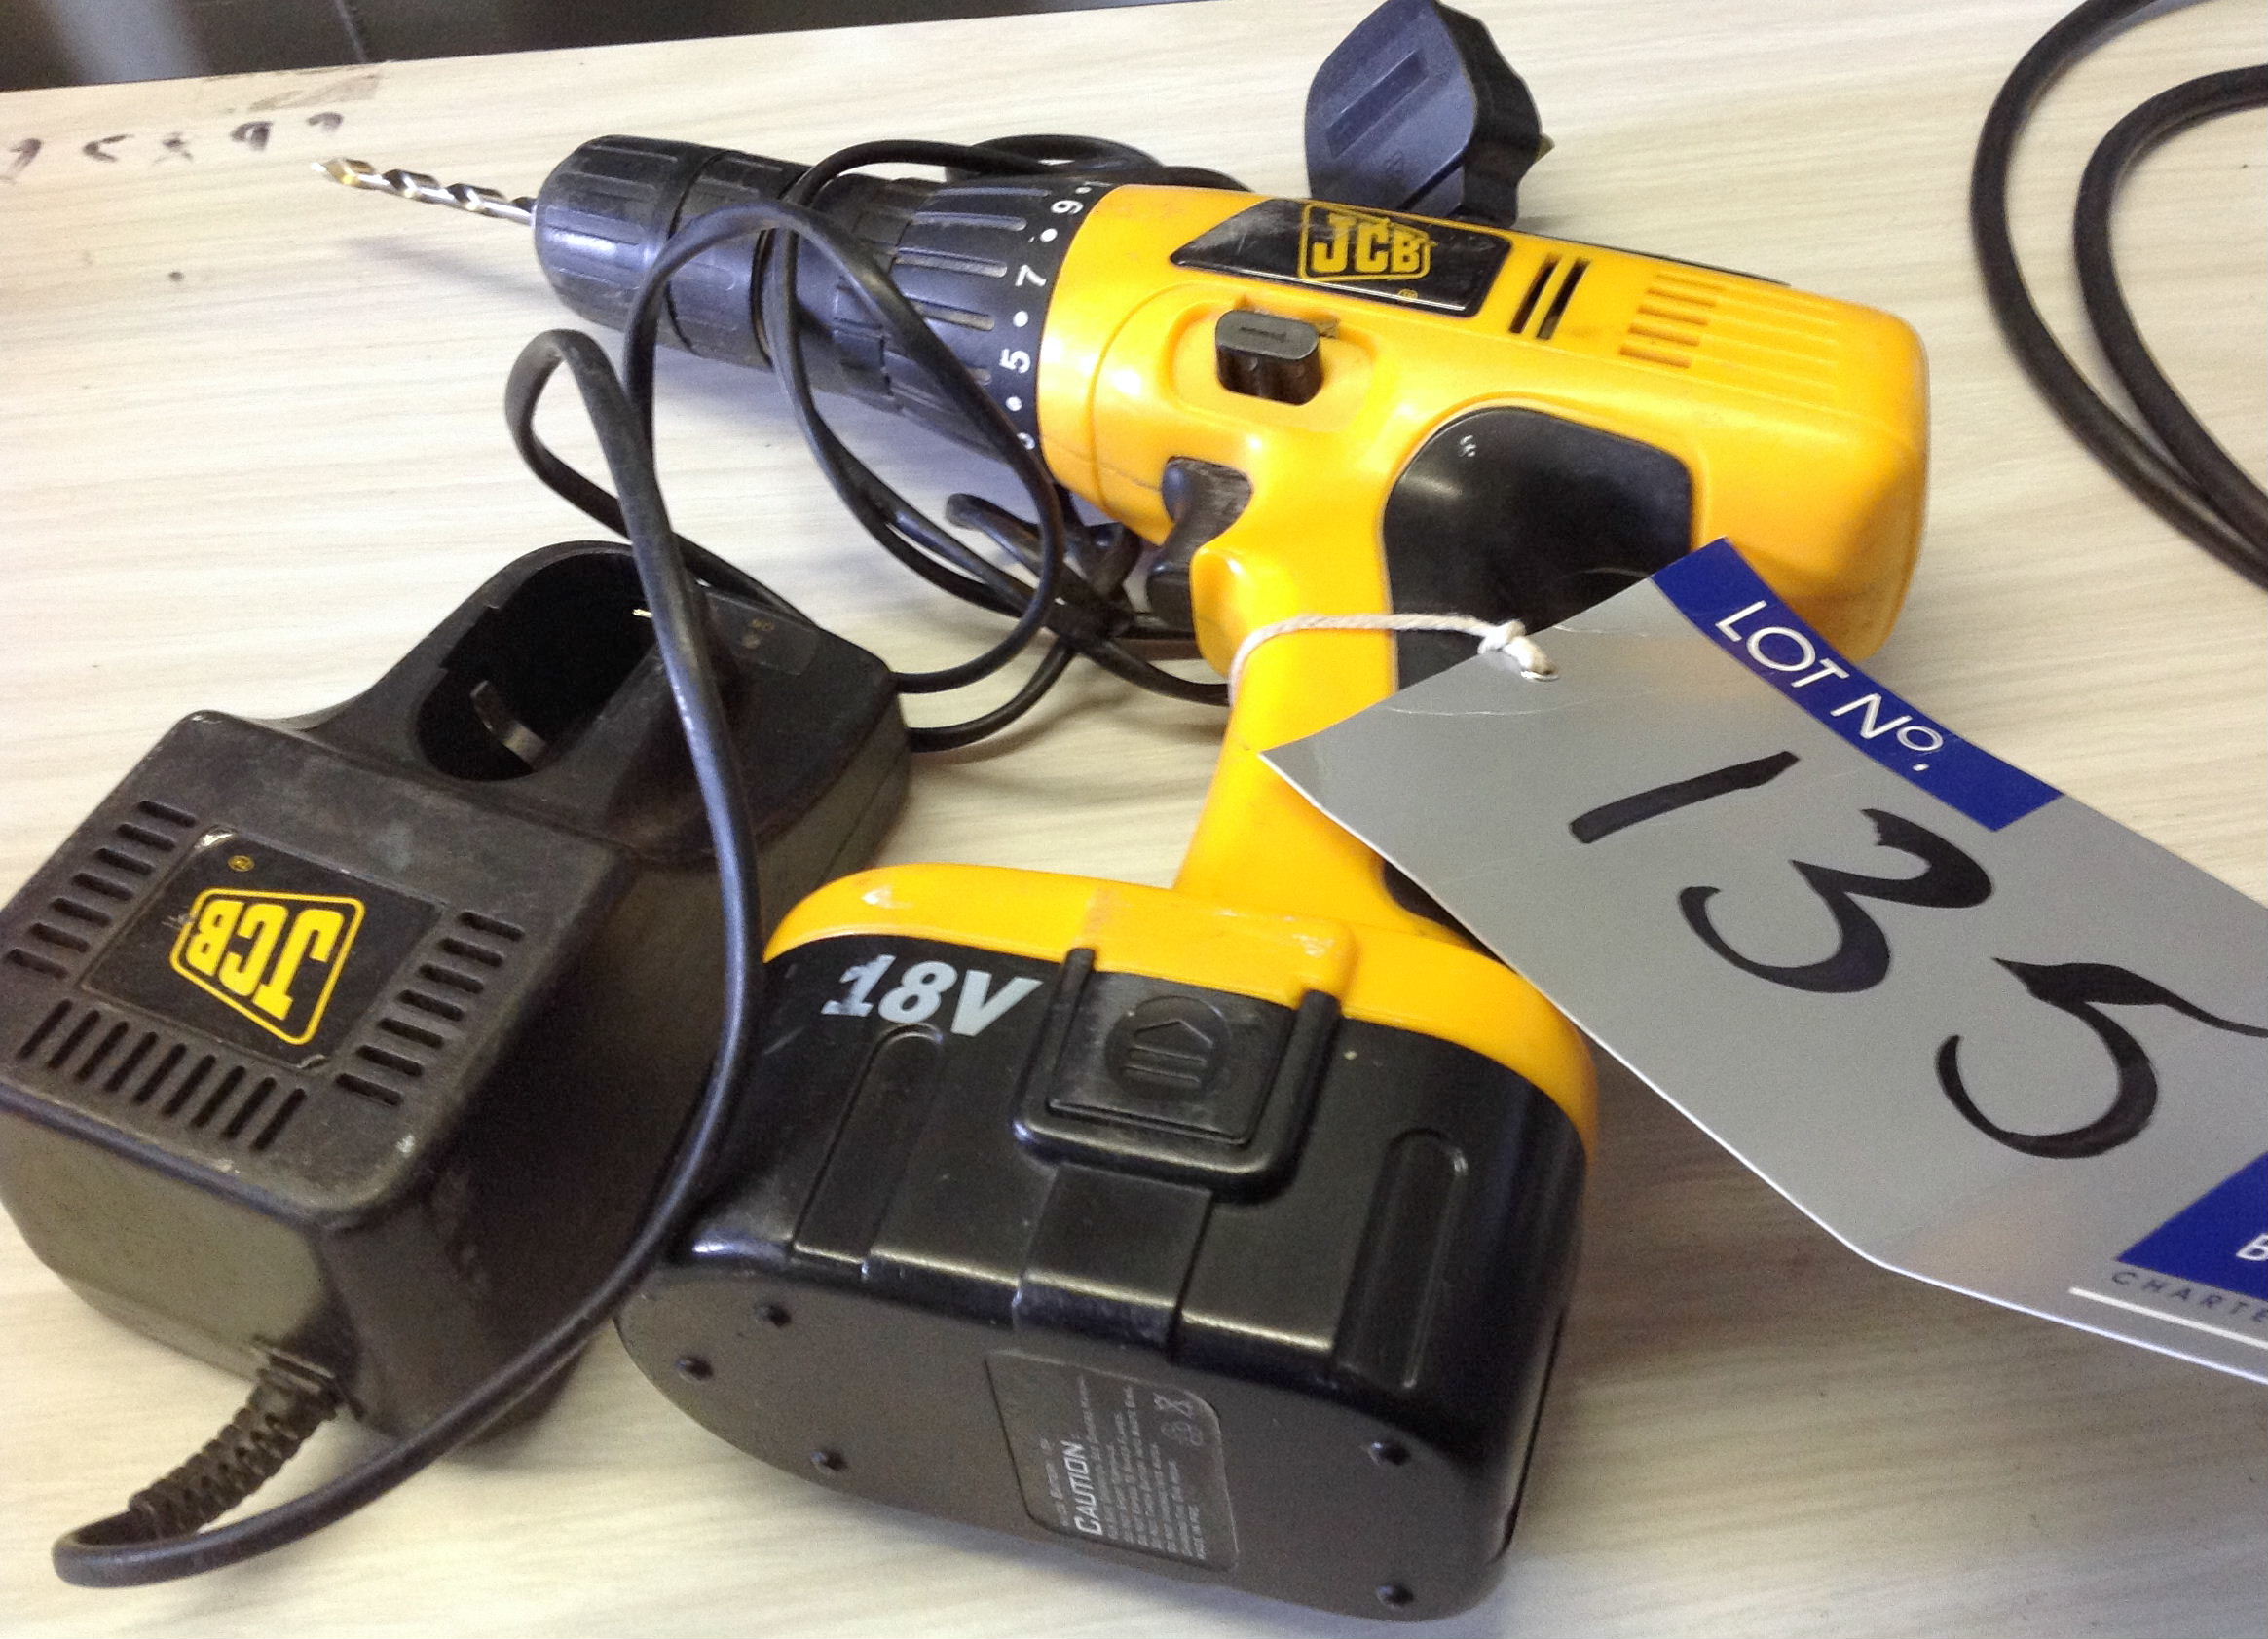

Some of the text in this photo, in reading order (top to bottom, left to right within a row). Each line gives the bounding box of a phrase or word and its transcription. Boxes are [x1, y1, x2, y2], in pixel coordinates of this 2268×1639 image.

[1015, 264, 1047, 287] 7
[1312, 213, 1420, 273] JCB
[999, 348, 1031, 374] 5
[1715, 600, 1850, 688] LOT
[186, 900, 345, 1021] JCB
[821, 954, 1044, 1036] 18V
[1570, 751, 2268, 1158] 135
